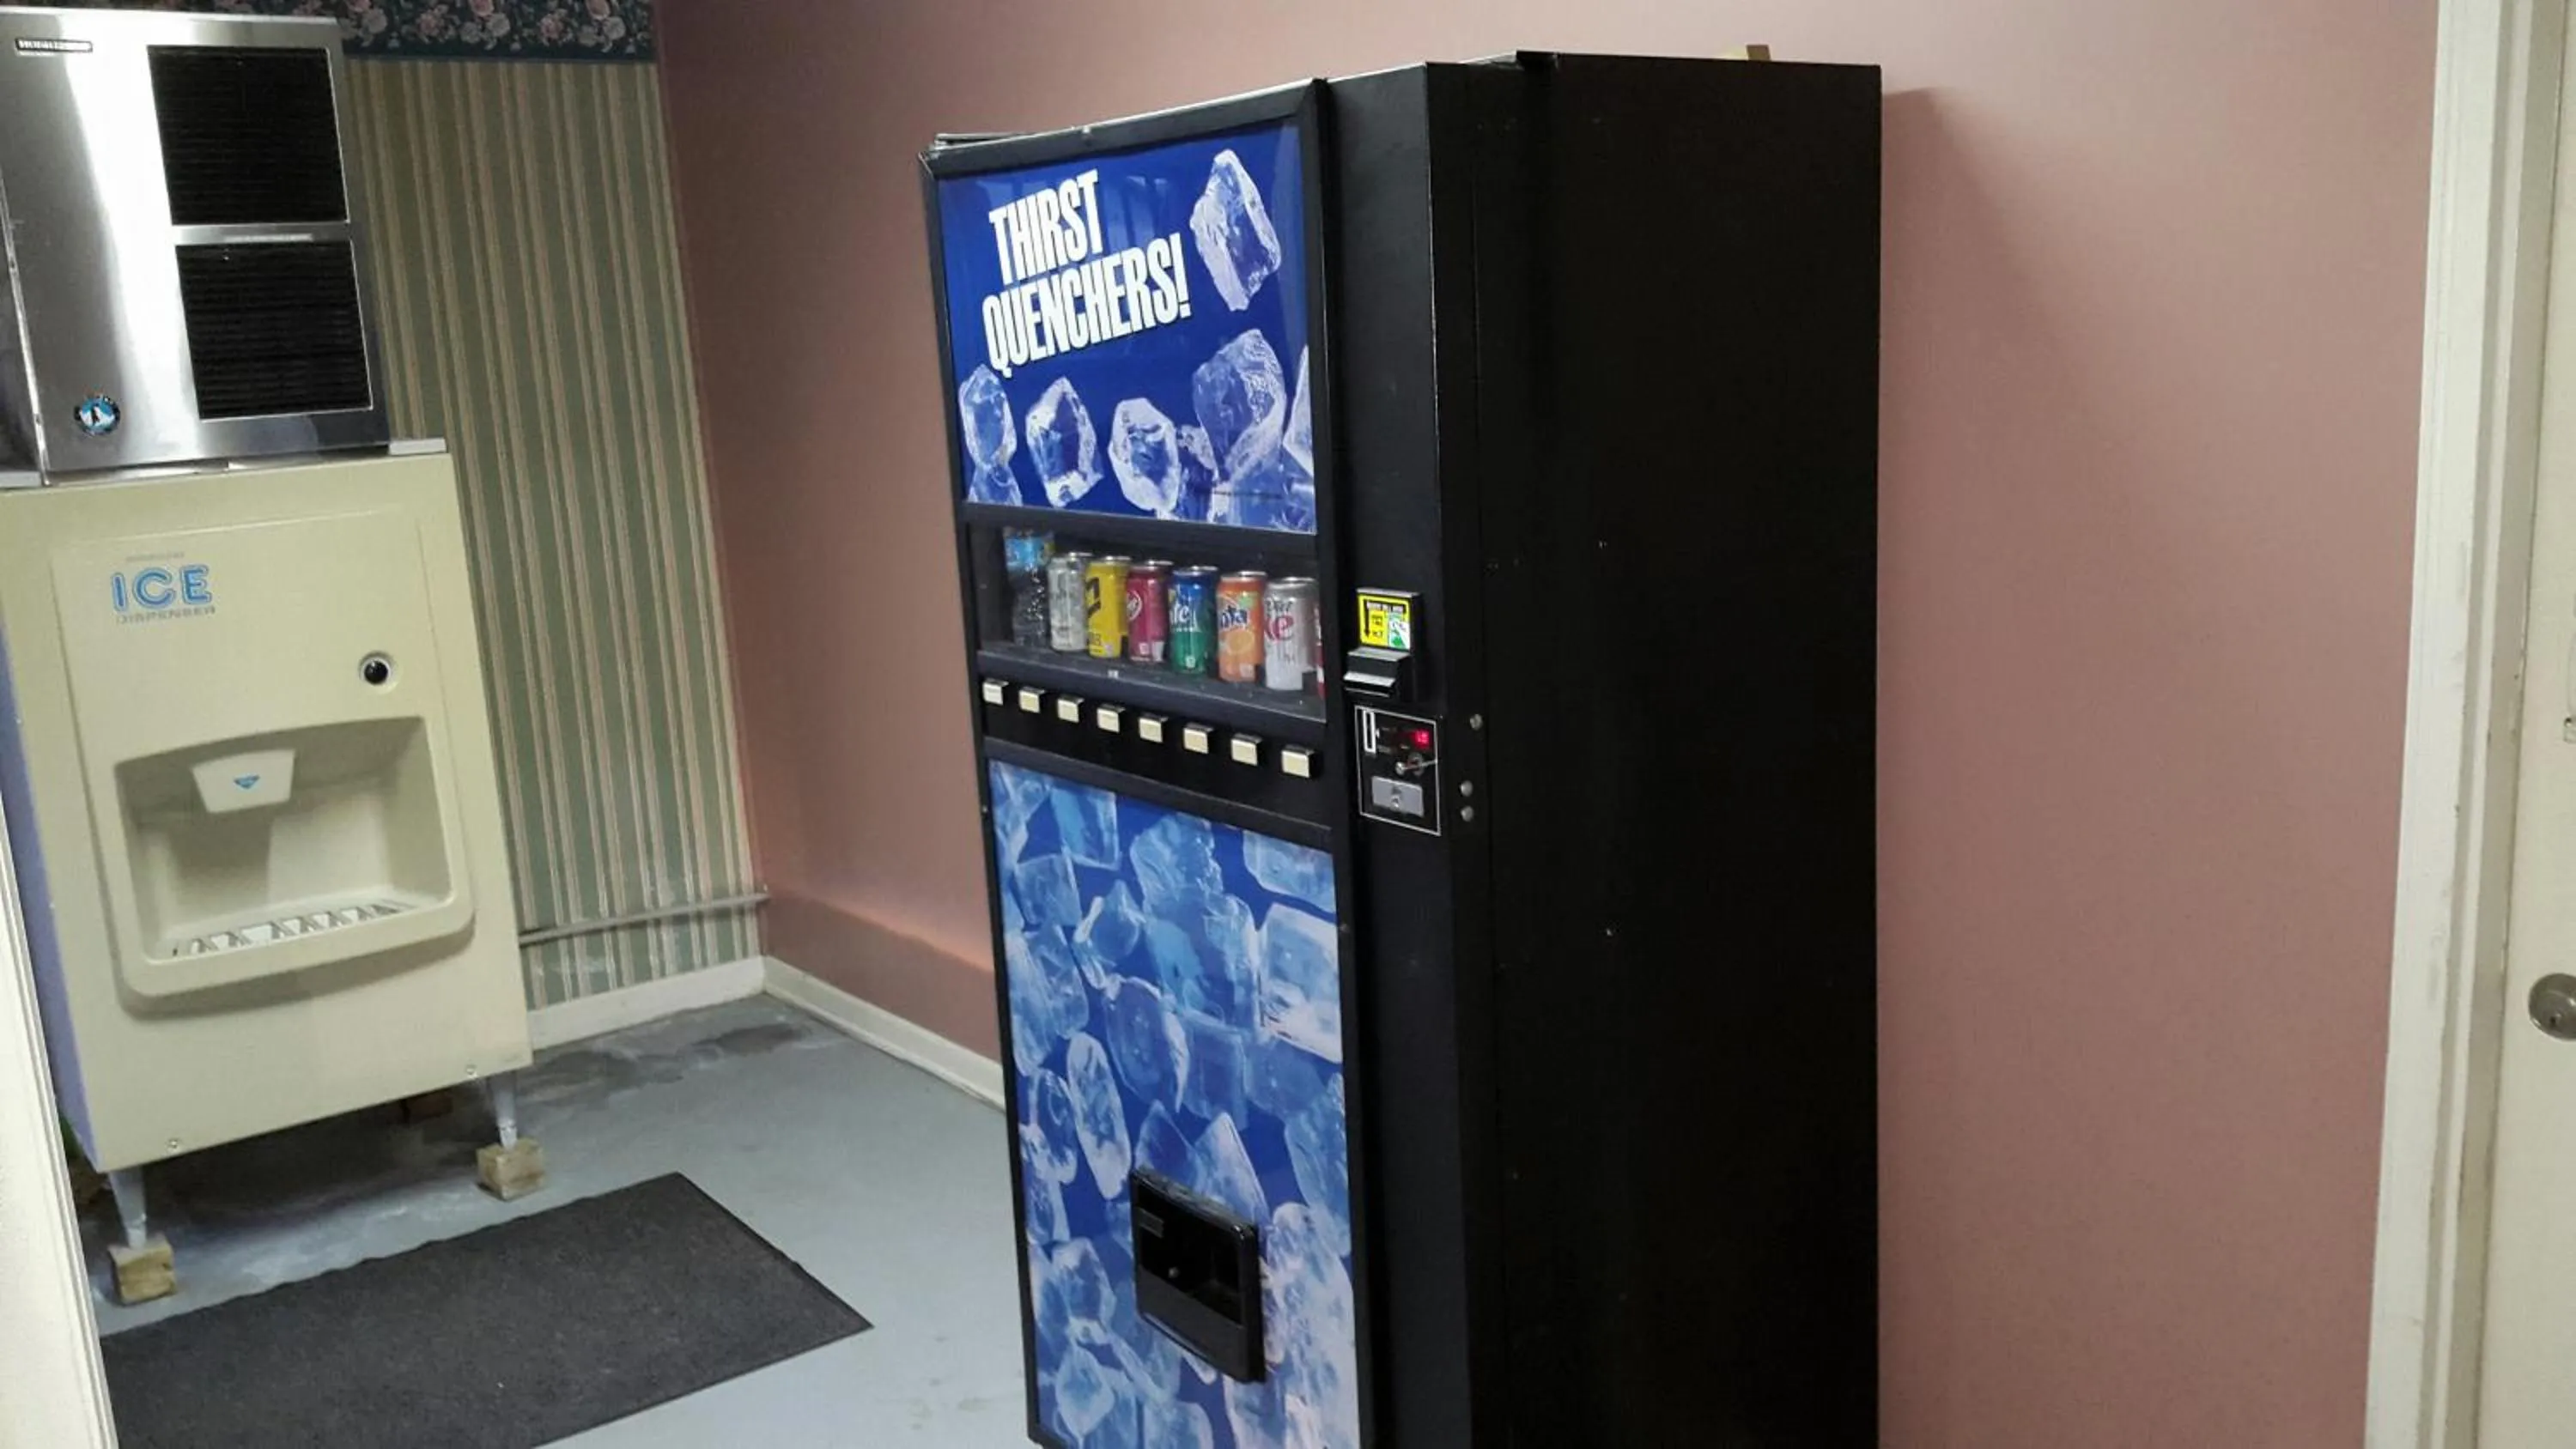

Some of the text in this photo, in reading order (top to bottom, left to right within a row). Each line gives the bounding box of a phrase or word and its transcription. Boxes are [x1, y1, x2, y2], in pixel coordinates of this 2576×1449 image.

[988, 169, 1103, 285] THIRST
[982, 233, 1191, 378] QUENCHERS!
[112, 564, 212, 612] ICE
